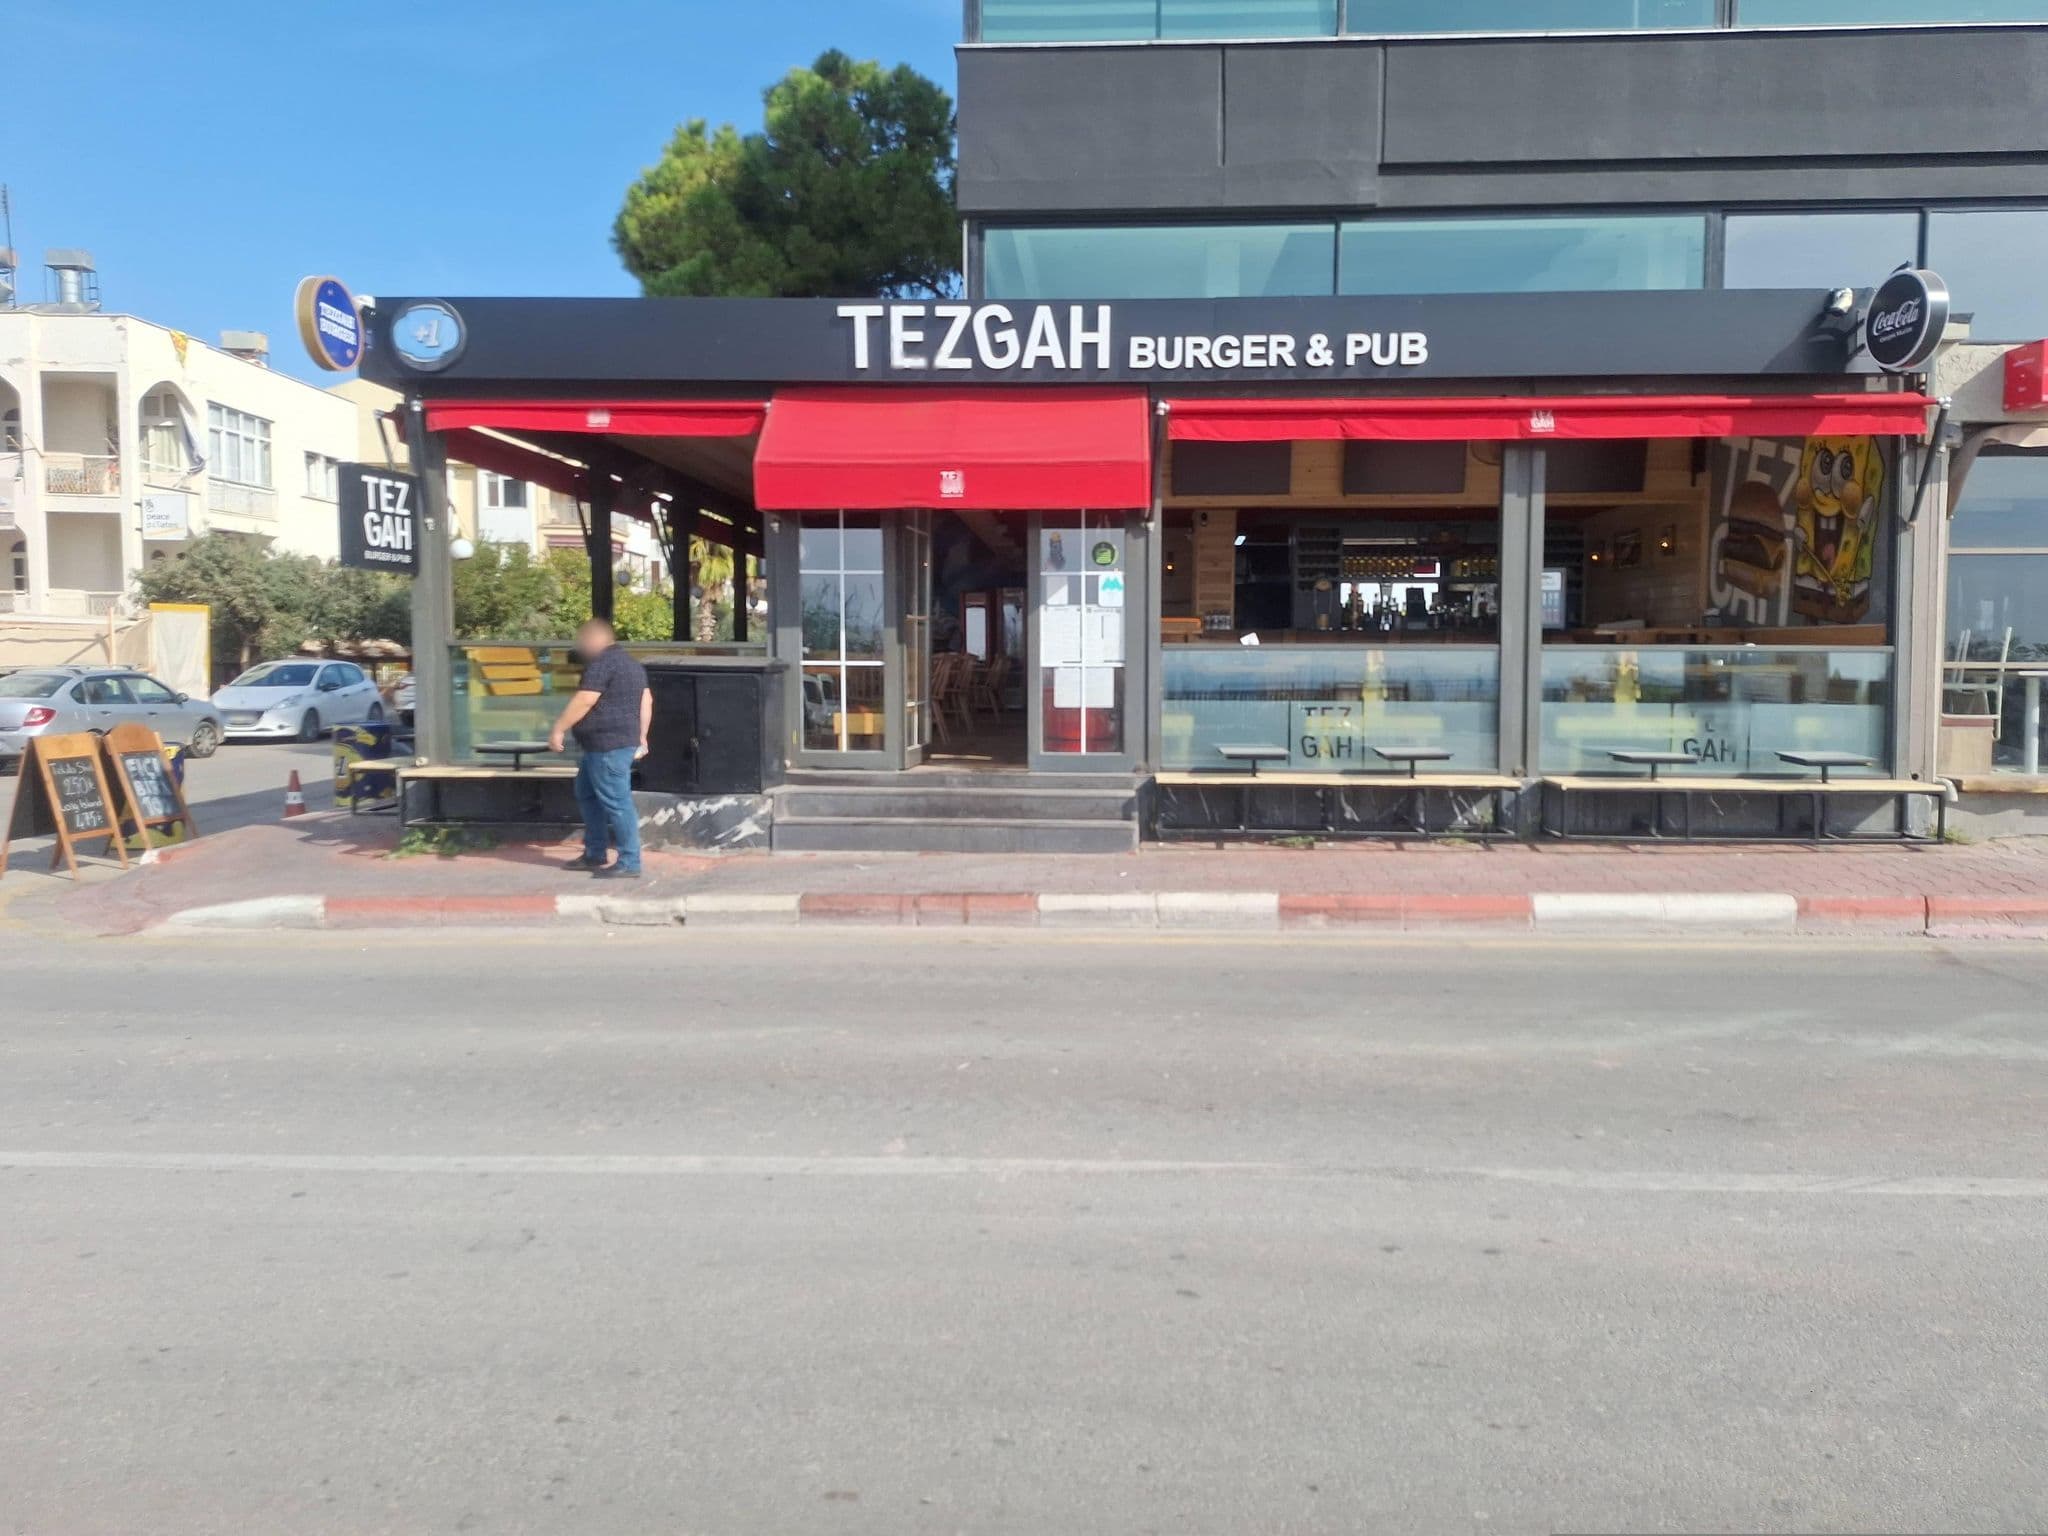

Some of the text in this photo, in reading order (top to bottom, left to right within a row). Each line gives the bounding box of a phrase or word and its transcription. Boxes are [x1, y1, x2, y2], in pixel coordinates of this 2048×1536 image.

[837, 304, 1429, 370] TEZGAH BURGER & PUB
[361, 475, 411, 515] TEZ
[363, 511, 412, 551] GAH
